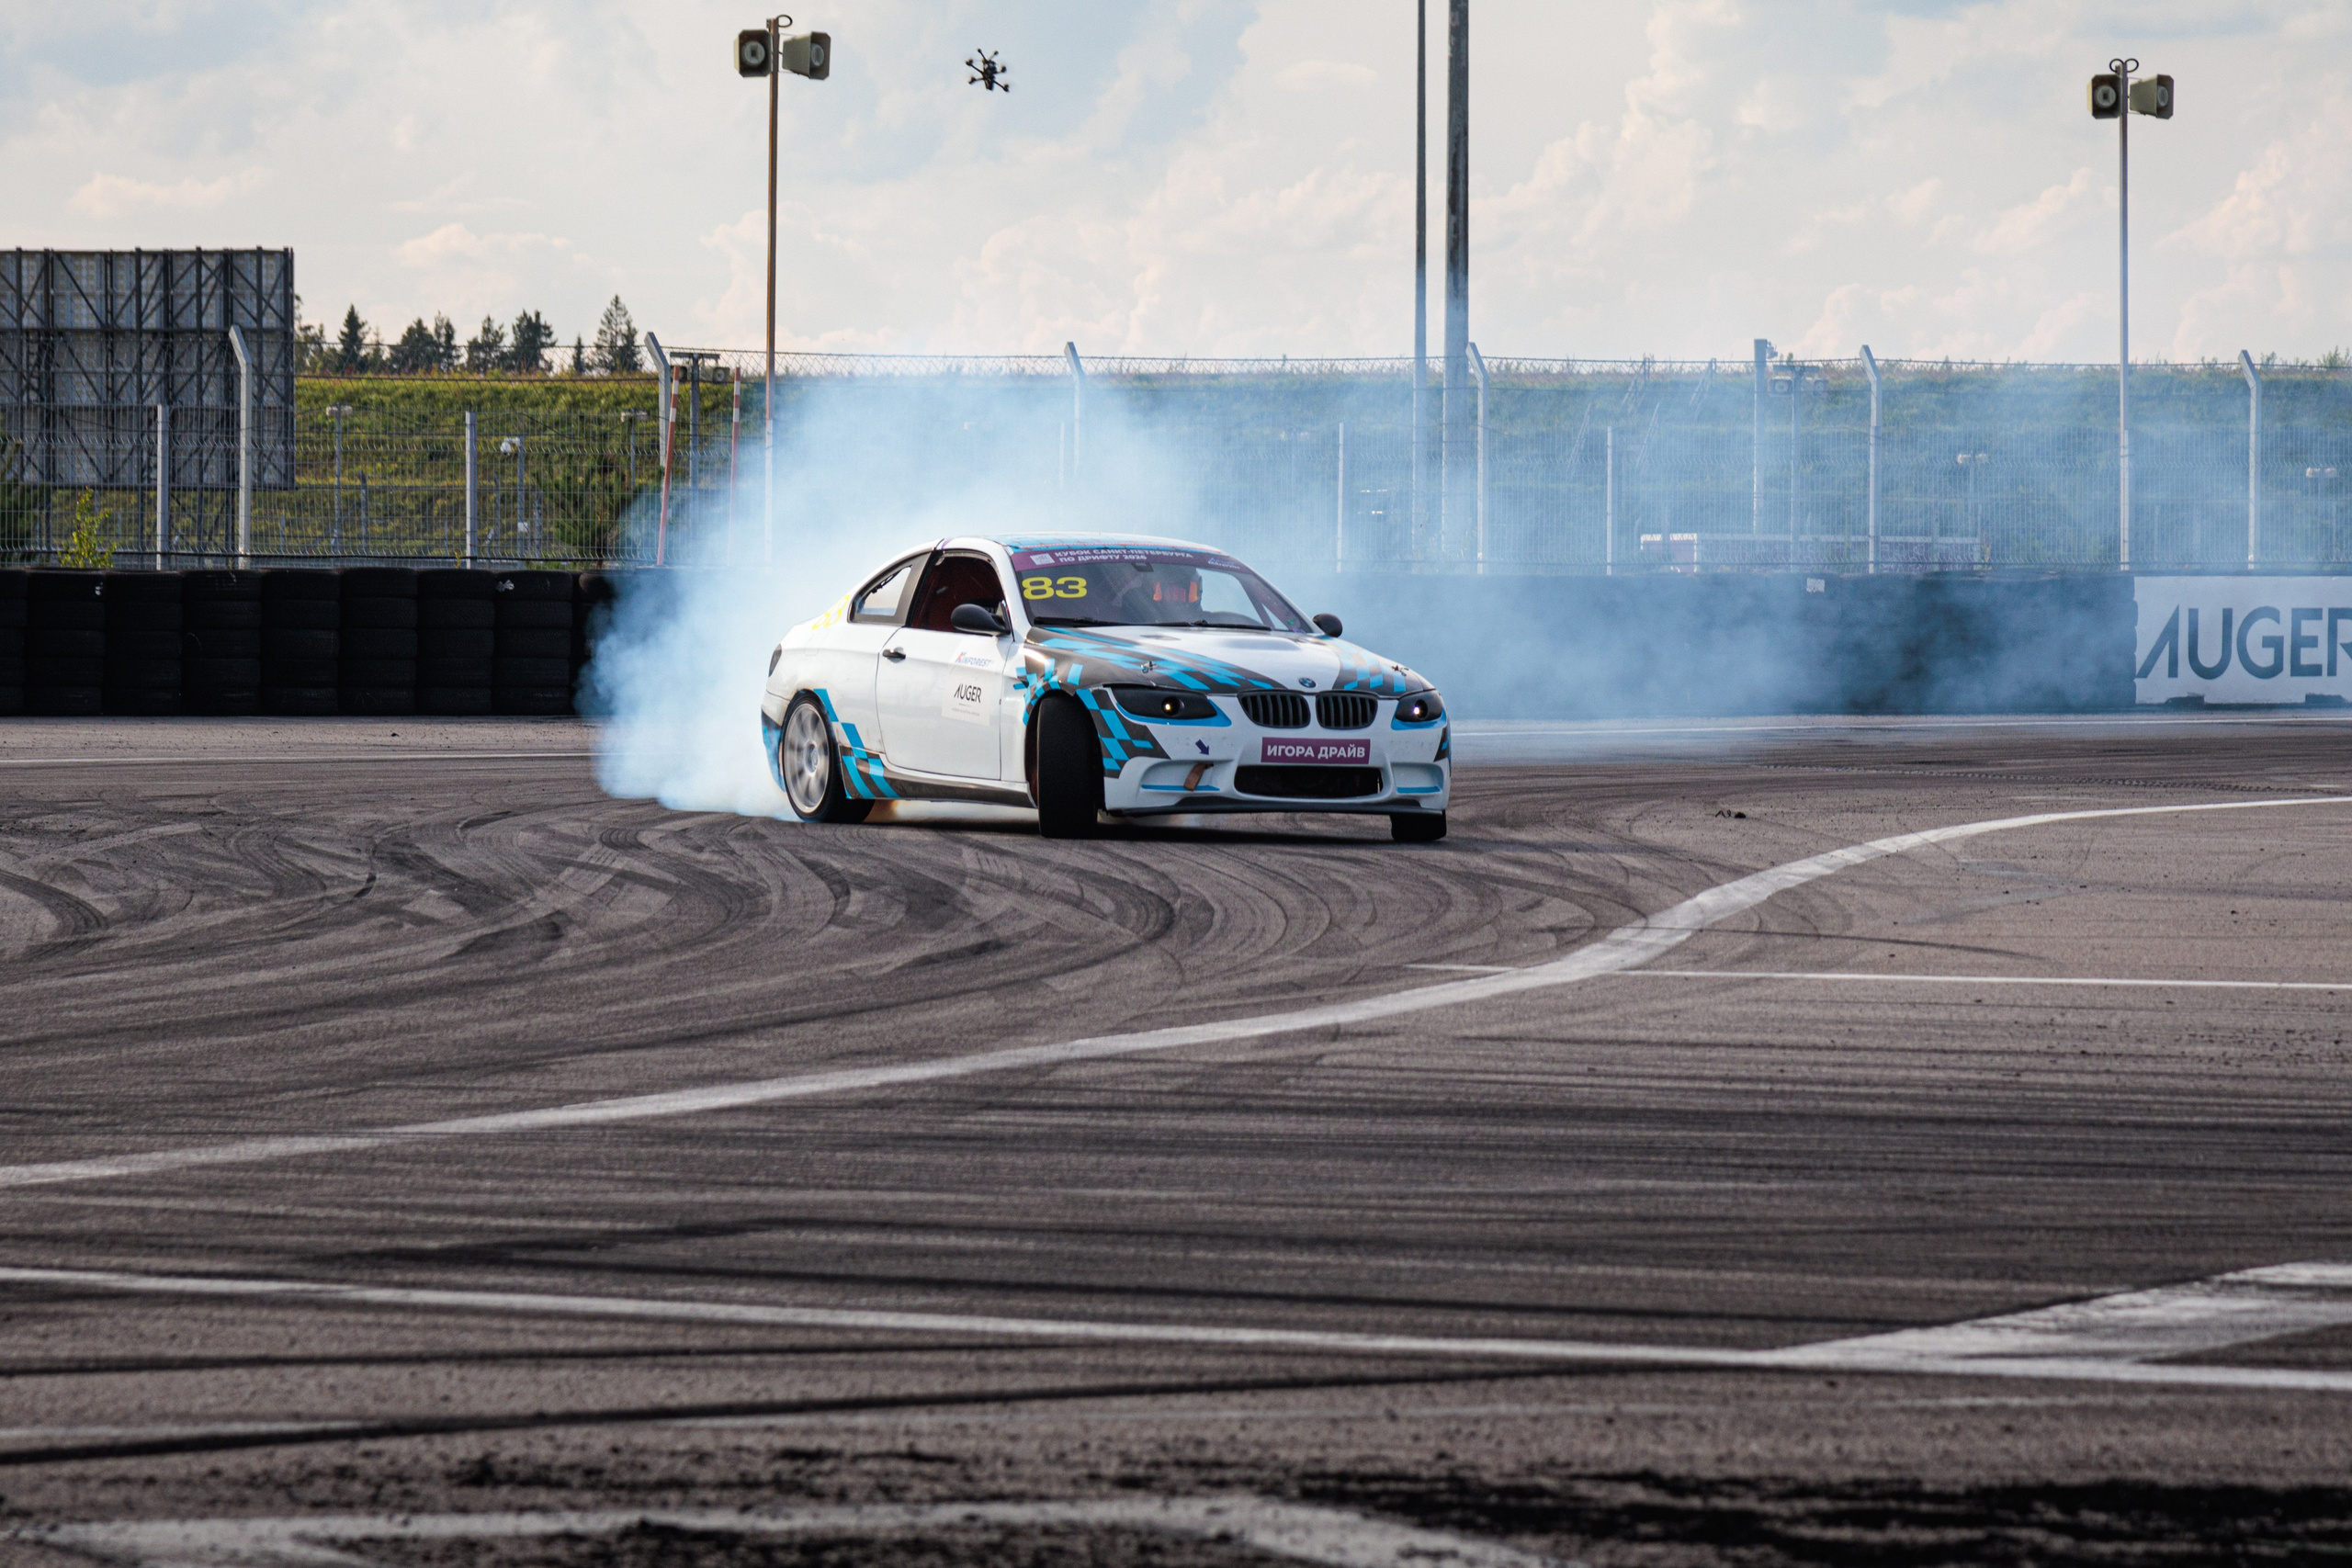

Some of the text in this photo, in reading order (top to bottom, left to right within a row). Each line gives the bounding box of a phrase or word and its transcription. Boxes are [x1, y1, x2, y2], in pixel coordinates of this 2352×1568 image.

[1055, 549, 1091, 558] КУБОК
[1078, 554, 1120, 562] ДРИФТУ
[1022, 576, 1087, 600] 83
[2135, 603, 2352, 681] AUGER
[954, 683, 982, 704] AUGER
[1267, 744, 1365, 760] ИГОРА ДРАЙВ
